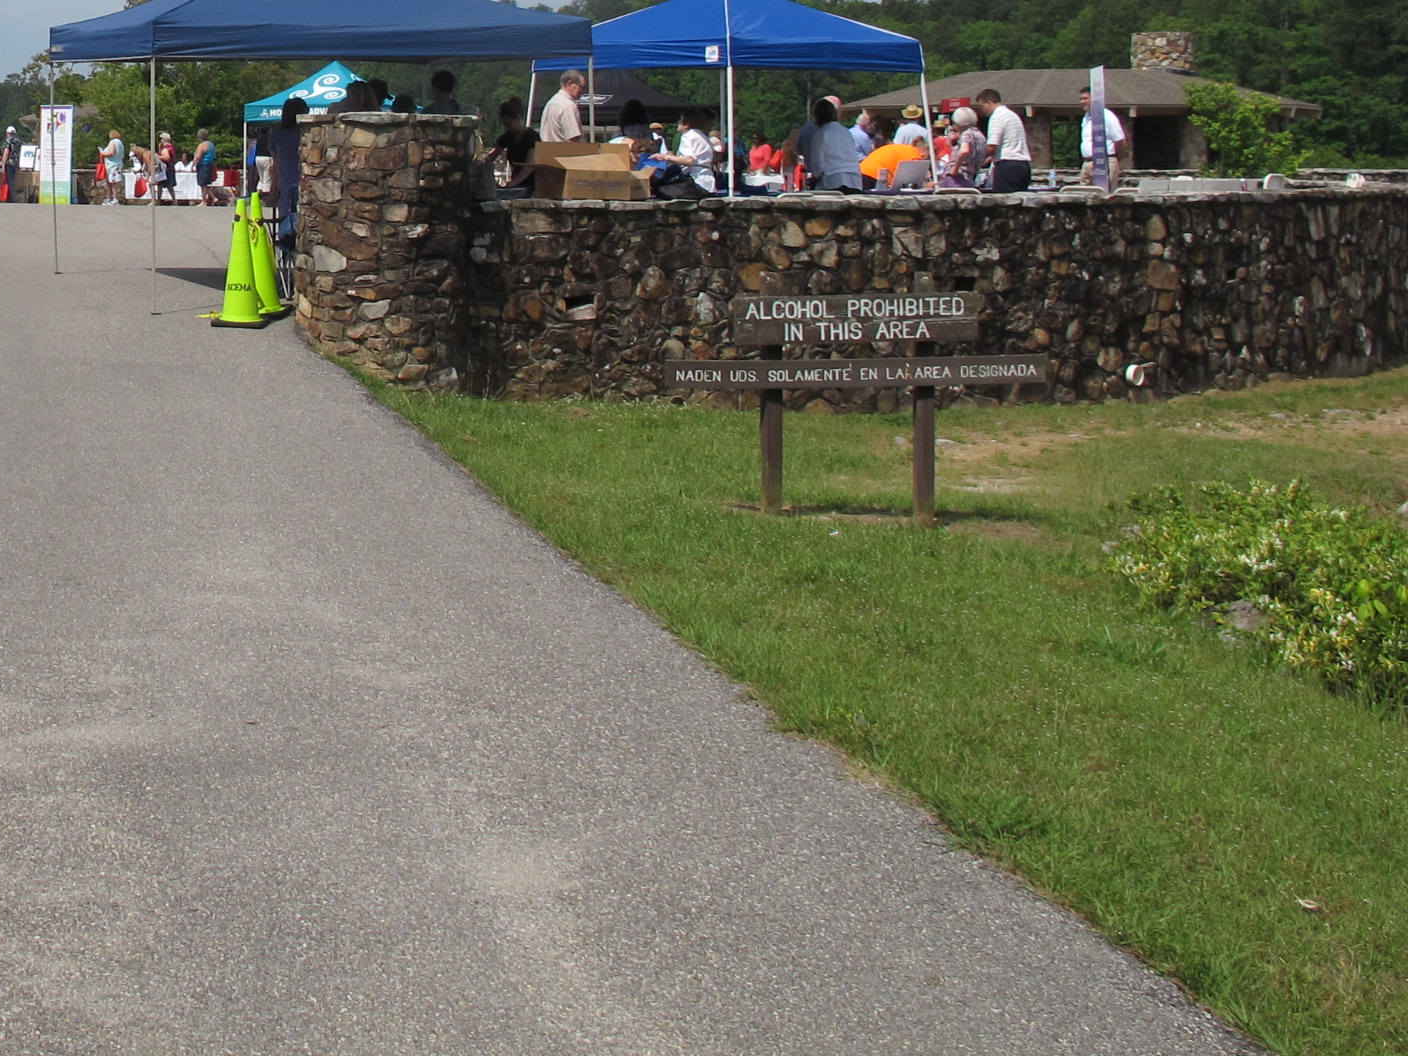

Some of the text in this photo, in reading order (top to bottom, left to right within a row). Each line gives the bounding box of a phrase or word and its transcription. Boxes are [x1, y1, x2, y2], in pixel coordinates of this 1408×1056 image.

[745, 297, 965, 320] ALCOHOL PROHIBITED
[784, 321, 930, 341] IN THIS AREA
[675, 369, 722, 382] NADEN
[730, 369, 759, 382] UDS.
[860, 367, 878, 380] EN
[914, 365, 952, 380] AREA
[961, 363, 1038, 378] DESIGNADA
